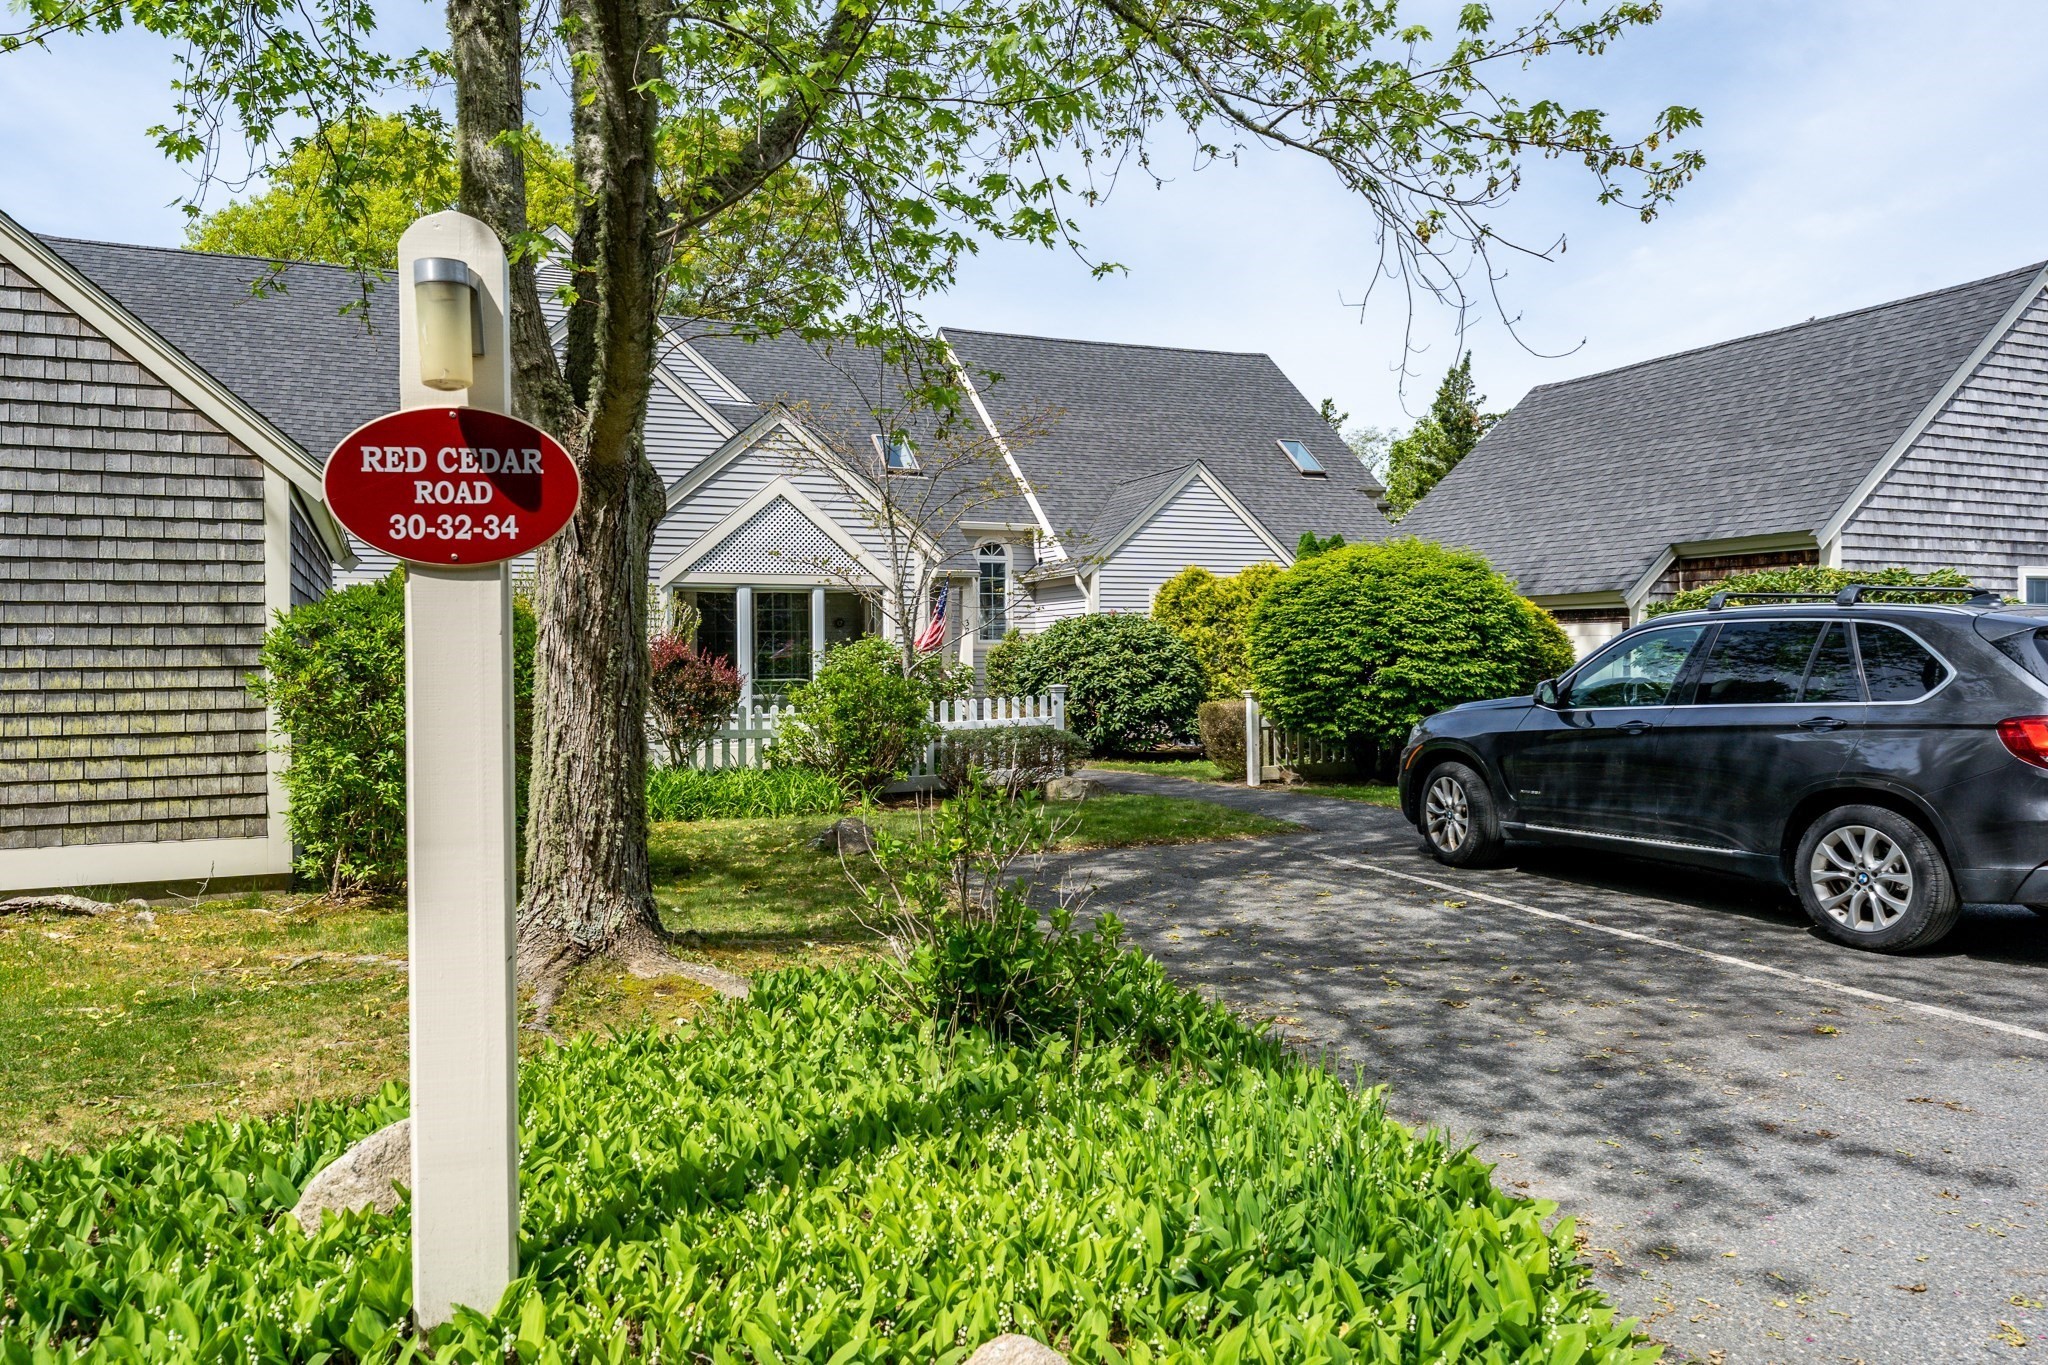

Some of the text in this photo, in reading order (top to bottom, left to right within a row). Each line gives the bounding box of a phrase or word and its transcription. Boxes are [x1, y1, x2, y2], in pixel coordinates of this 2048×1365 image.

[360, 446, 544, 474] RED CEDAR
[413, 480, 493, 504] ROAD
[389, 514, 519, 540] 30-32-34
